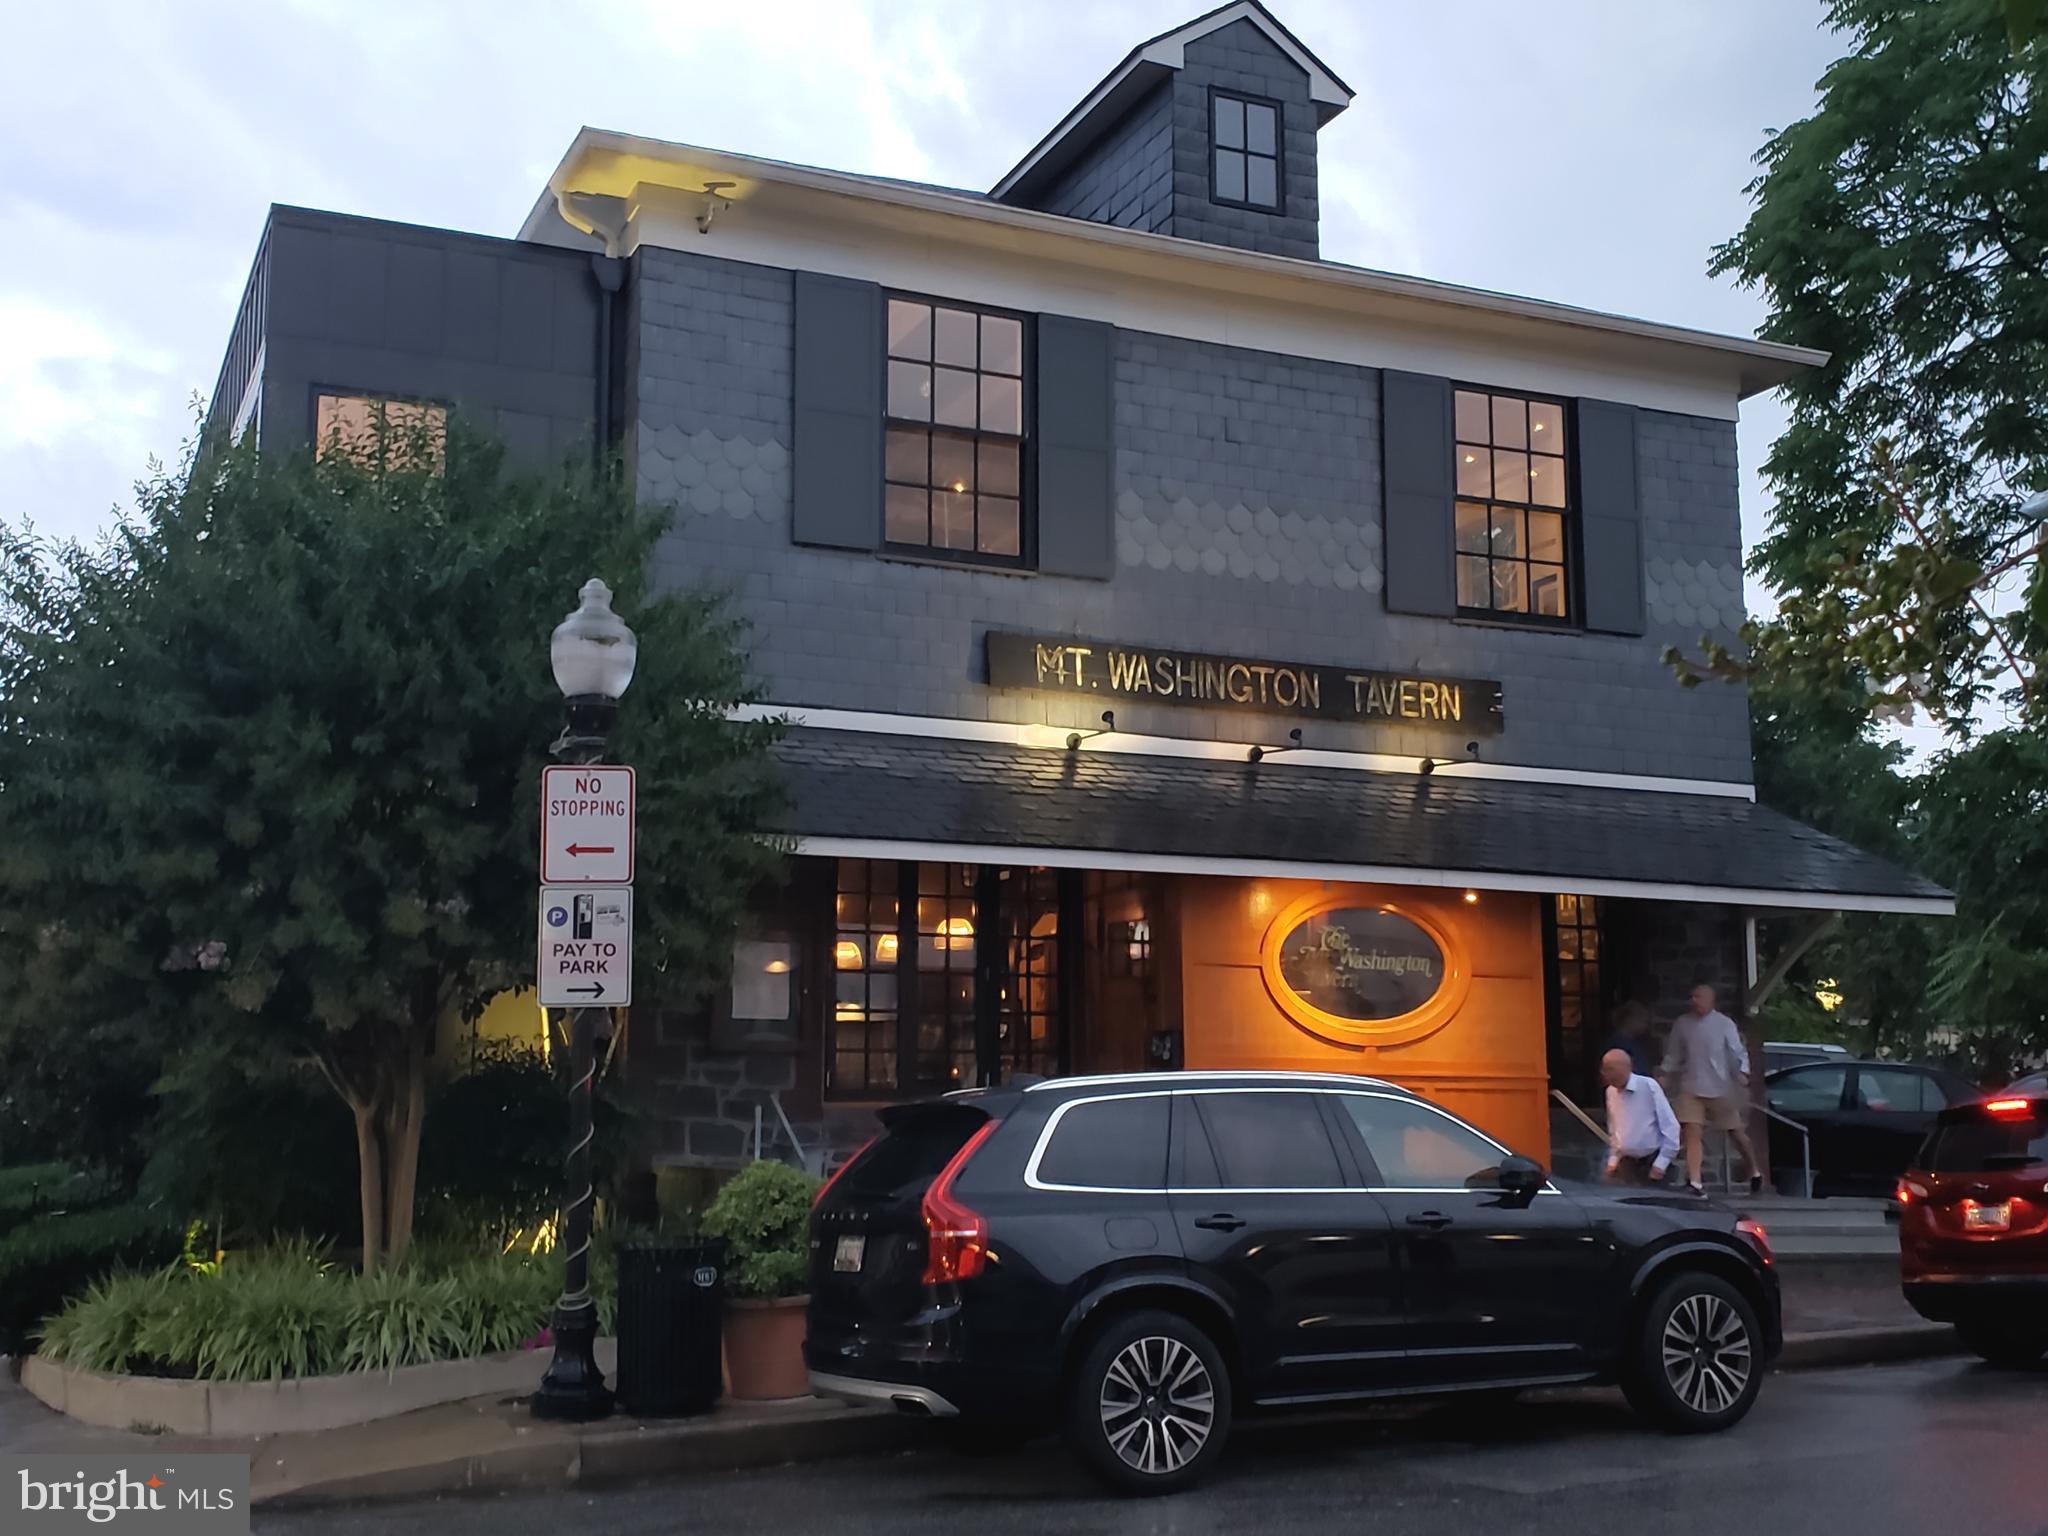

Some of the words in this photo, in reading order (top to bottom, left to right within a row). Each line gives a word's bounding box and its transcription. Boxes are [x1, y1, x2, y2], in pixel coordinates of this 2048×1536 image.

[1036, 643, 1098, 687] MT.
[1107, 651, 1321, 709] WASHINGTON
[1345, 675, 1461, 721] TAVERN
[575, 778, 602, 794] NO
[551, 800, 625, 816] STOPPING
[553, 944, 586, 957] PAY
[592, 943, 616, 957] TO
[559, 960, 608, 974] PARK
[1340, 947, 1433, 978] Washington
